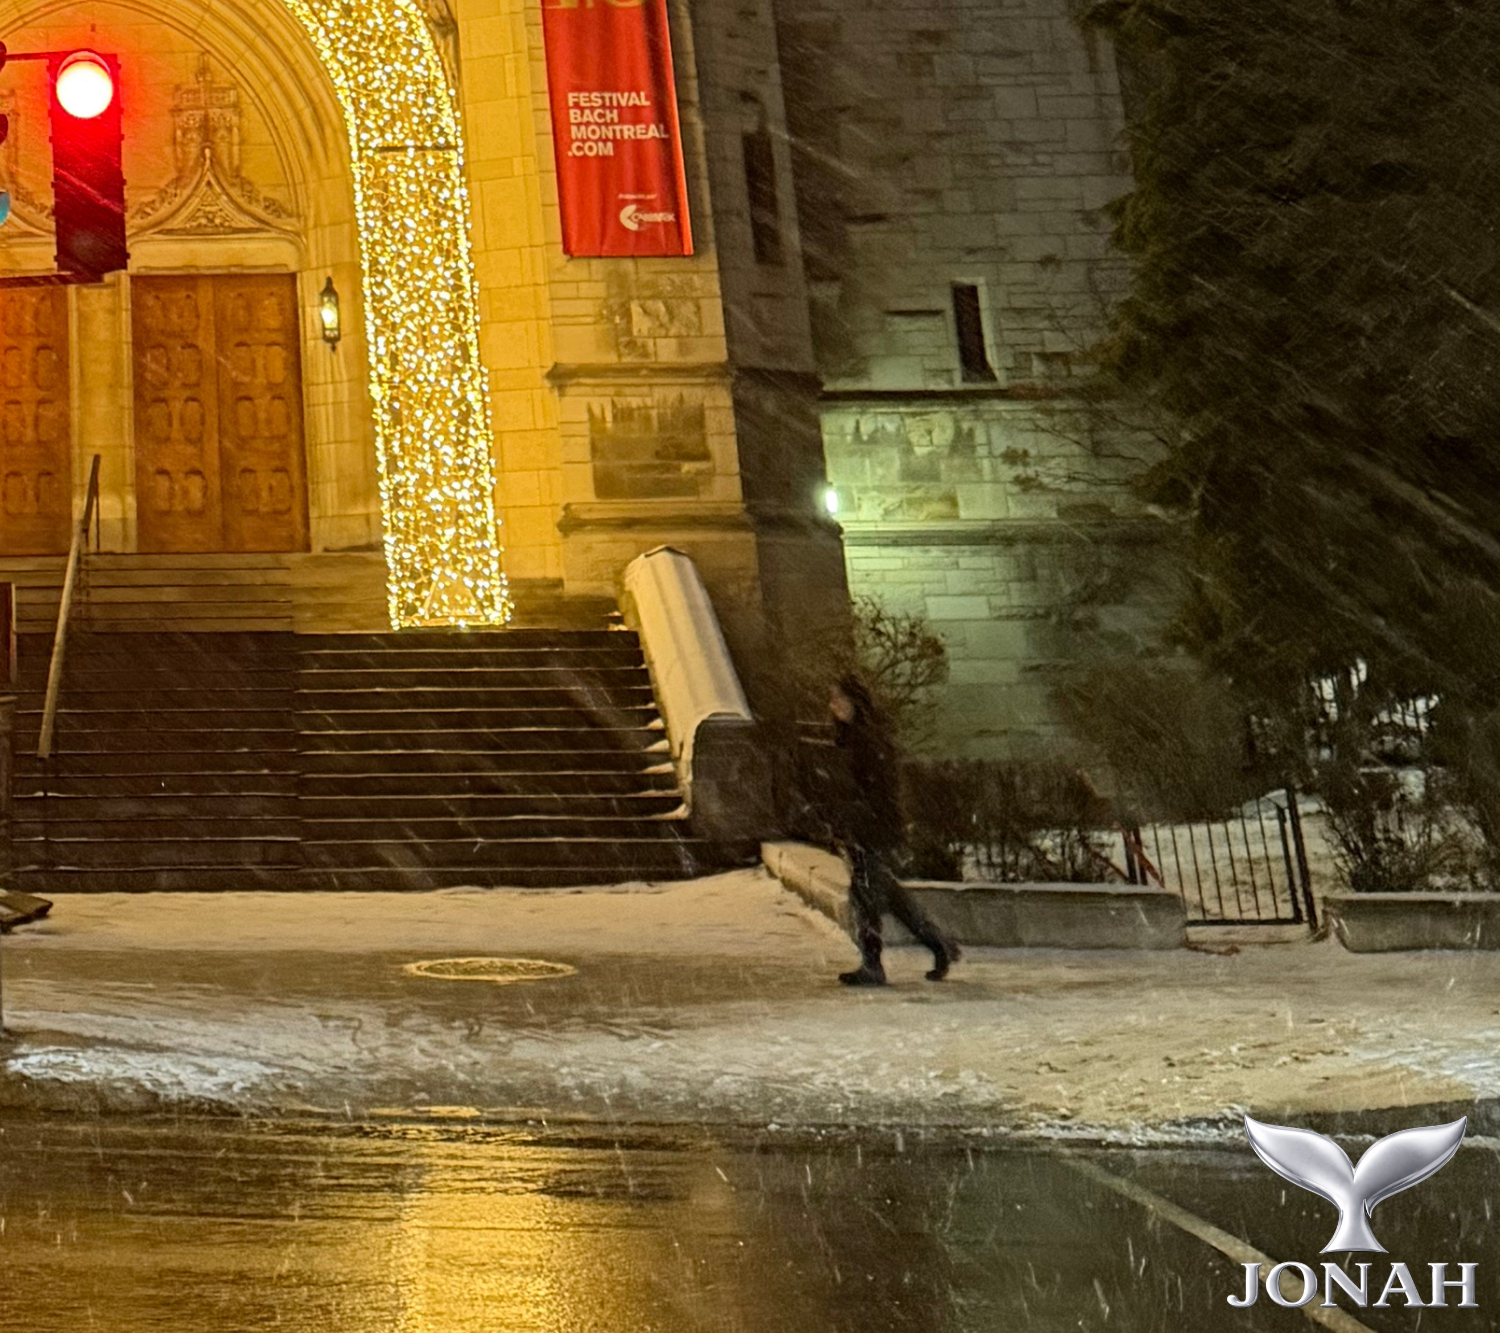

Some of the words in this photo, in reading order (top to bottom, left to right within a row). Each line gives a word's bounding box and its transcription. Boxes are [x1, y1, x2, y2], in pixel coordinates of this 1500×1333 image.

[567, 92, 650, 107] FESTIVAL
[569, 108, 619, 123] BACH
[570, 124, 669, 140] MONTREAL
[567, 142, 614, 157] .COM
